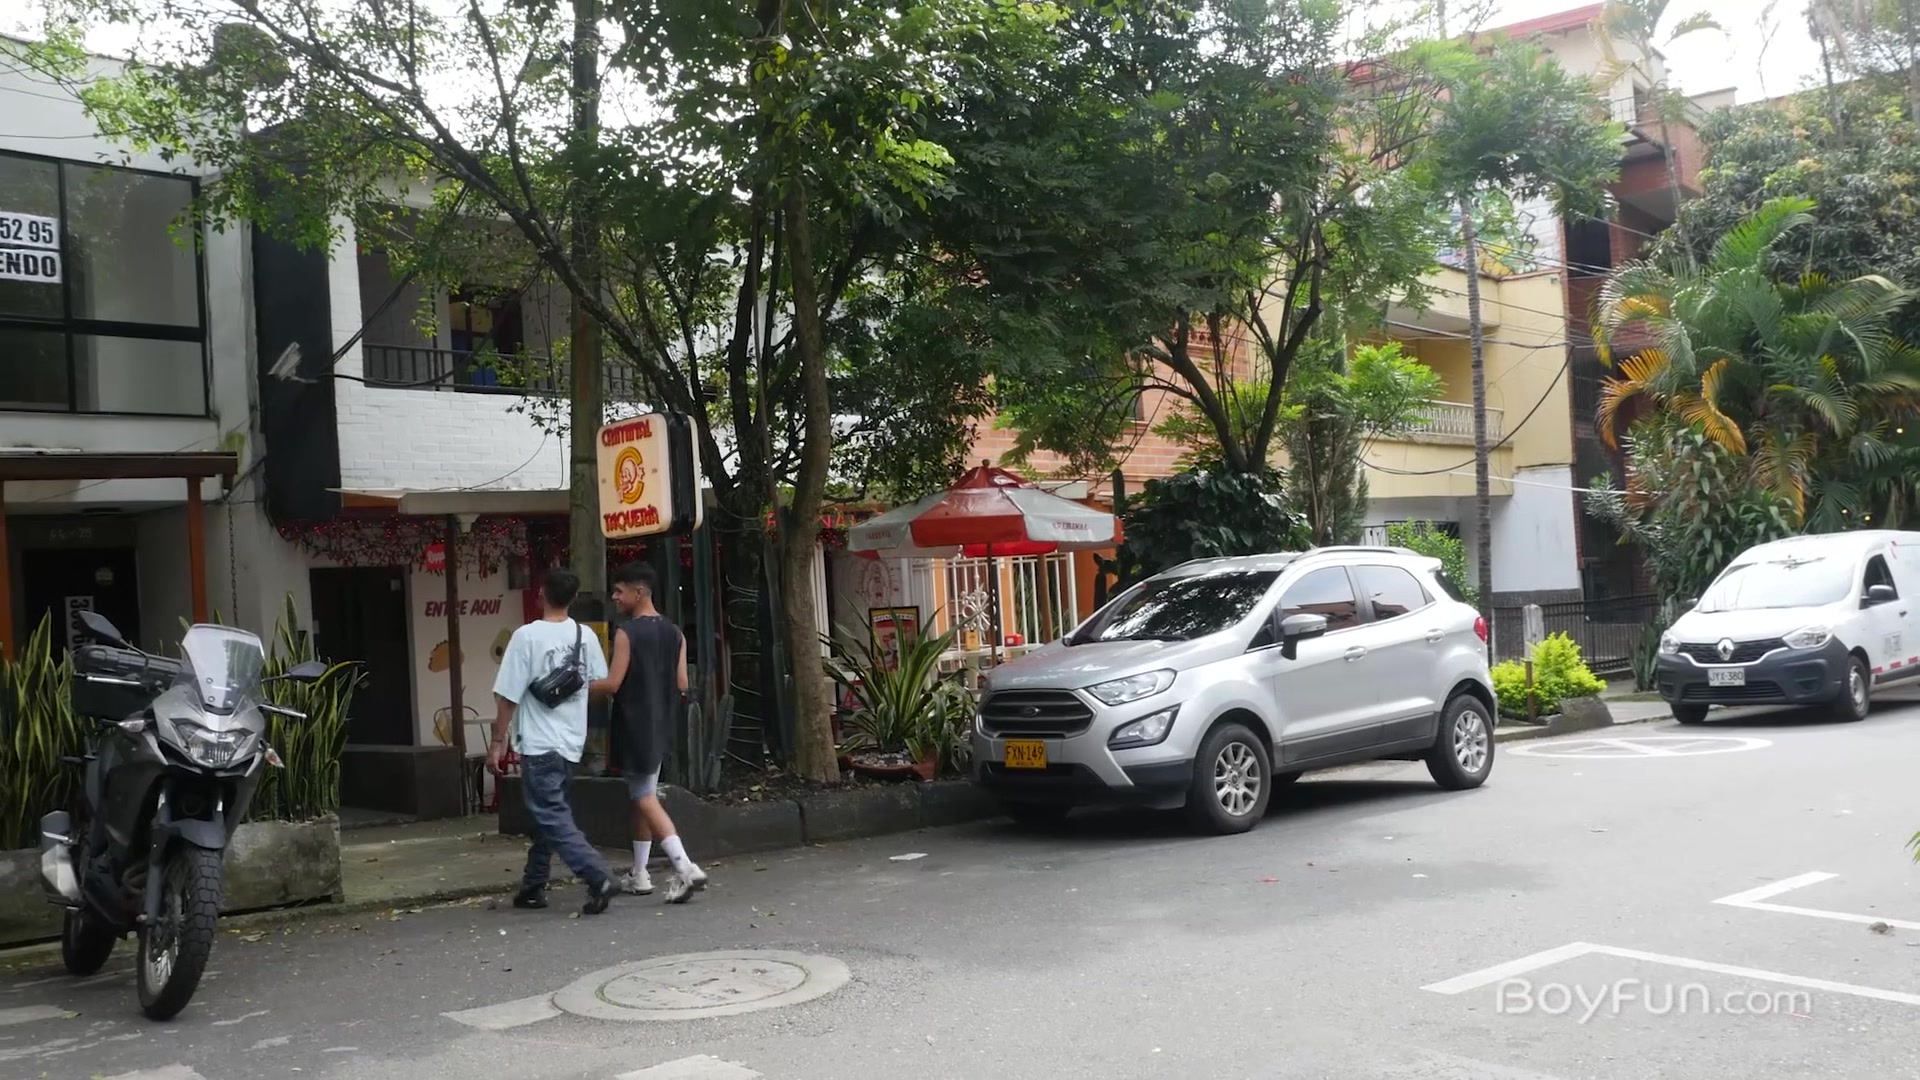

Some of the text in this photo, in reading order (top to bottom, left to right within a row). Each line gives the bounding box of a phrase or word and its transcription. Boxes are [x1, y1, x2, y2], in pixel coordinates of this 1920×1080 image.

[0, 217, 54, 244] 52 95
[601, 419, 653, 447] CRIMINAL
[425, 594, 504, 617] ENTE AQUÍ
[1006, 745, 1044, 761] FXN-149
